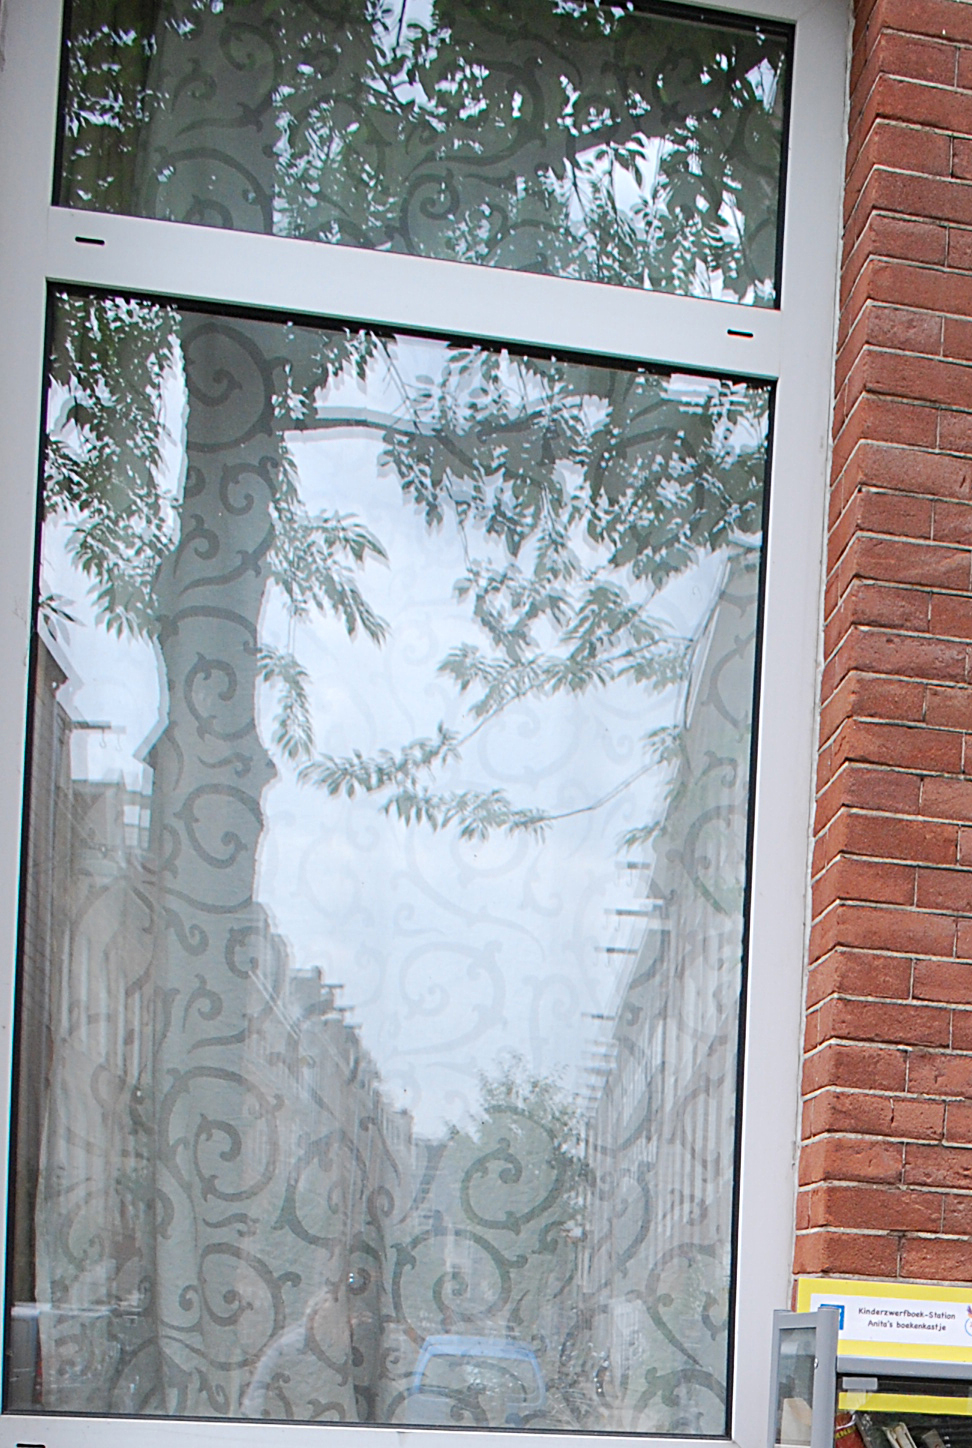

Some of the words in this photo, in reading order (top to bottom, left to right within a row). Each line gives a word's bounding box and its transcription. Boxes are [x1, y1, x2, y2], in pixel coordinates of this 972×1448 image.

[858, 1307, 956, 1320] Kinderzwerfboek-Station
[867, 1319, 893, 1329] Anita's
[896, 1321, 946, 1332] boekenkastje
